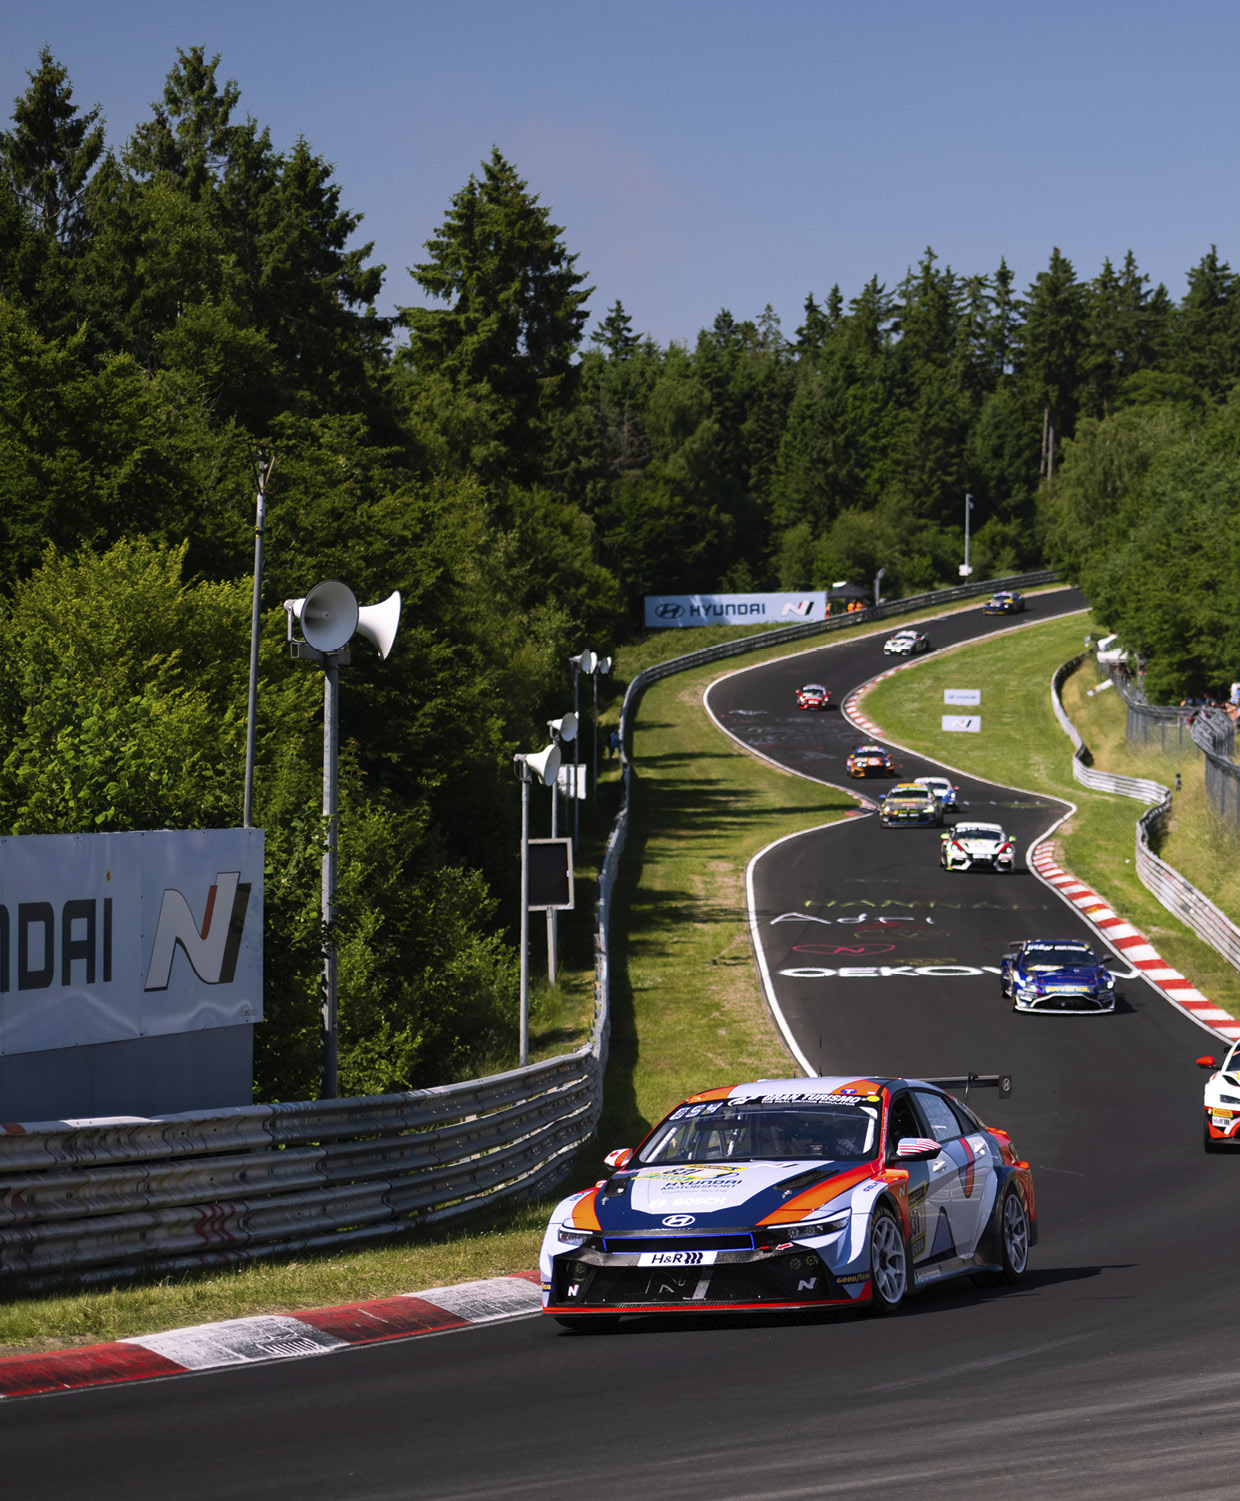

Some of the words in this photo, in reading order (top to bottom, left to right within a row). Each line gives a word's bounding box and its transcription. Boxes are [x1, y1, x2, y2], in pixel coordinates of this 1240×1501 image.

[690, 603, 765, 617] HYUNDAI
[0, 898, 113, 993] DAI
[763, 1093, 801, 1102] GRAN
[805, 1093, 862, 1104] TURISMO
[665, 1179, 742, 1187] HYUNDAI
[672, 1197, 726, 1206] BOSCH
[651, 1253, 683, 1264] H&R
[567, 1284, 580, 1297] N
